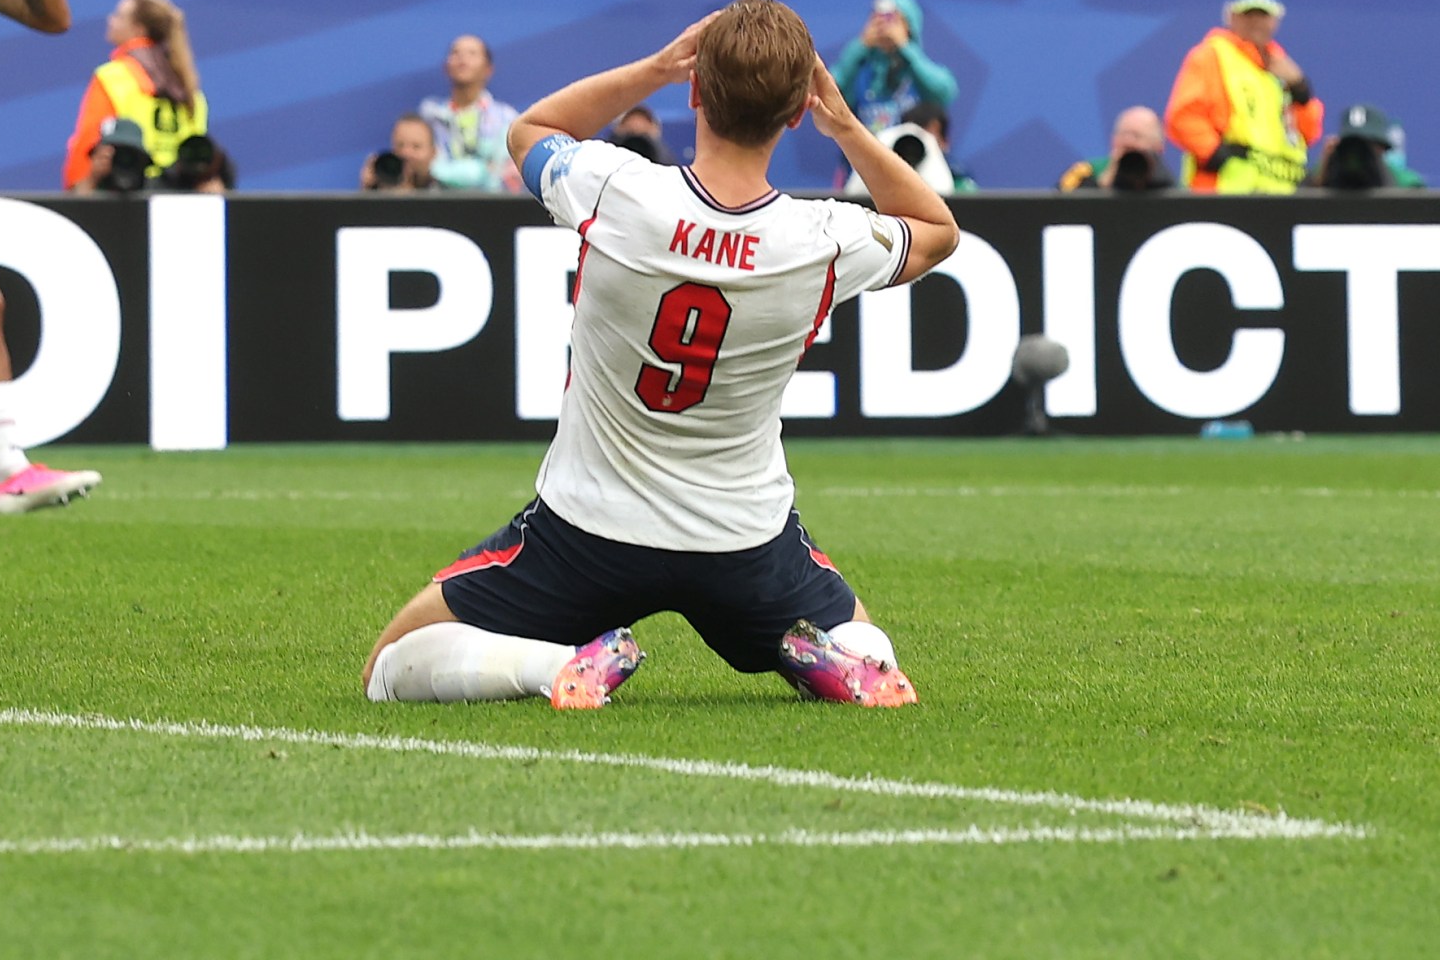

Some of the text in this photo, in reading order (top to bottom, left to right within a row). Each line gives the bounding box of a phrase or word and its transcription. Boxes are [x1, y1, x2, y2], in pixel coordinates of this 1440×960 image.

[669, 219, 760, 271] KANE
[337, 222, 1440, 421] PDICT
[634, 281, 732, 413] 9
